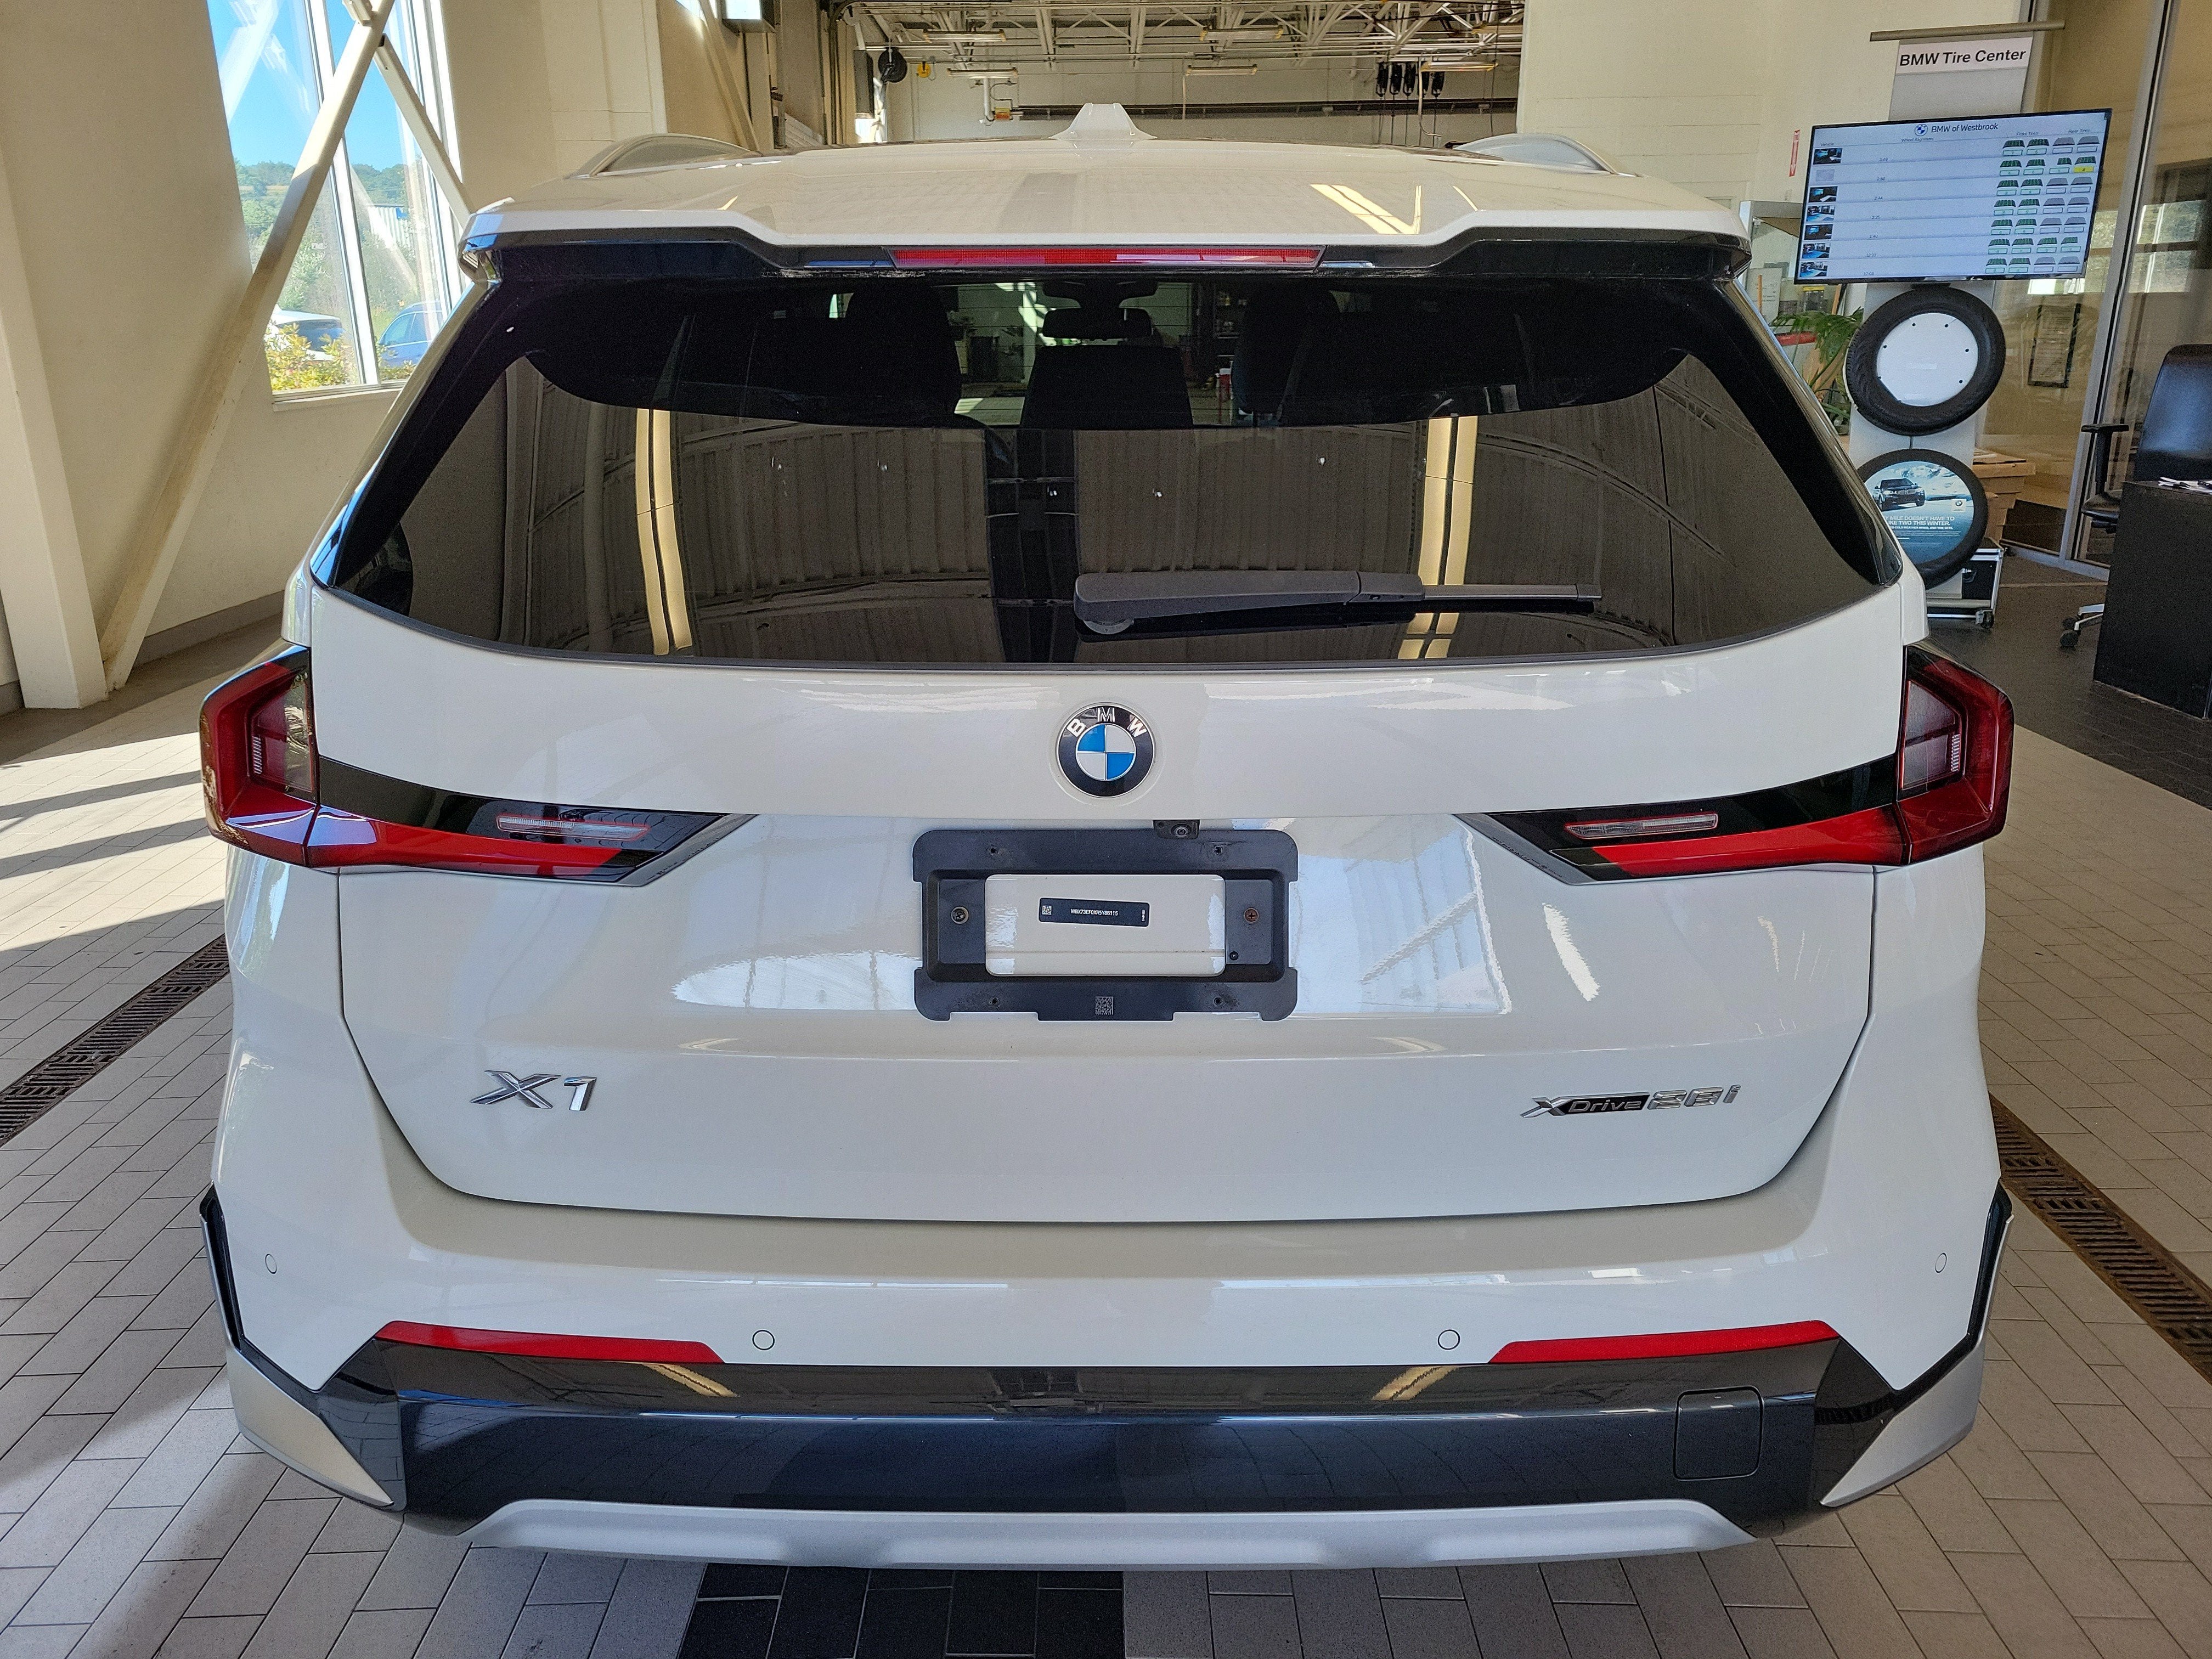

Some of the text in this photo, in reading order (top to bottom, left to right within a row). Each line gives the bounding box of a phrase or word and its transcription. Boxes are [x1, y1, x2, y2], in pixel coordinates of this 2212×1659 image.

[1899, 49, 2027, 66] BMW Tire Center
[1961, 123, 1999, 131] Westbrook
[1066, 707, 1148, 738] BMW
[469, 1069, 597, 1111] X1
